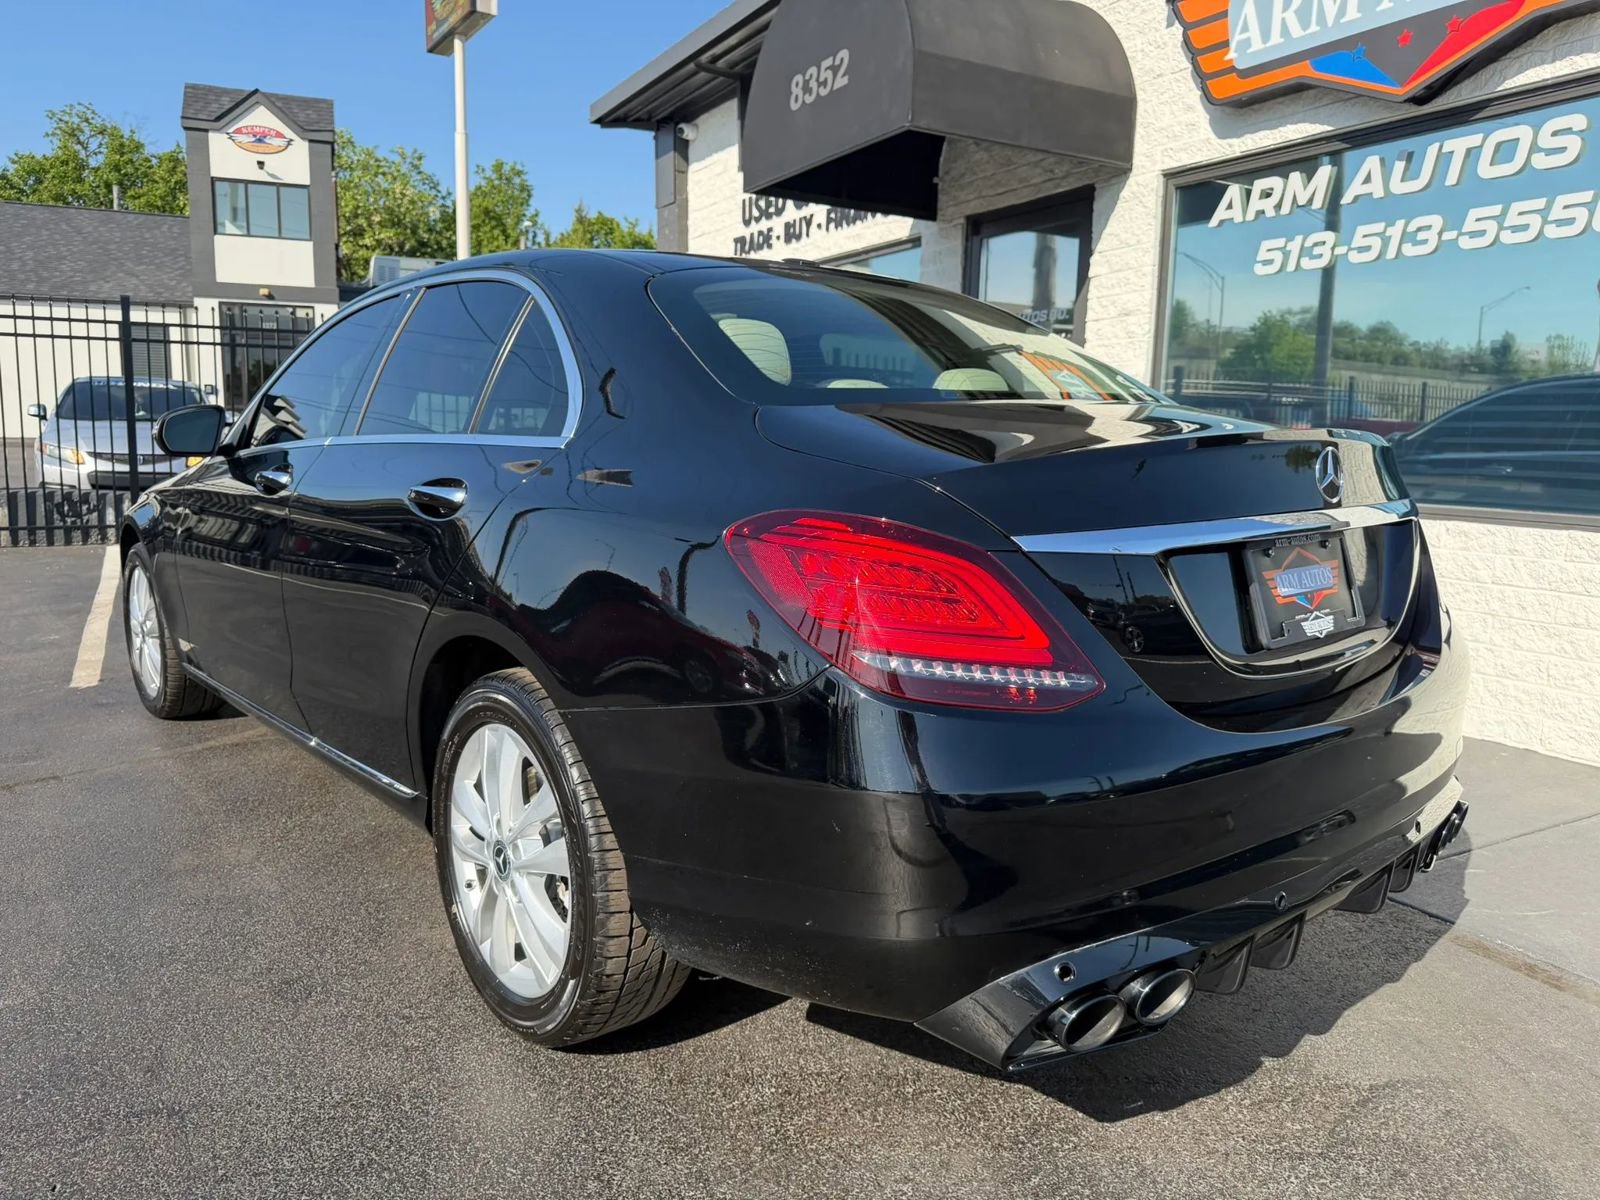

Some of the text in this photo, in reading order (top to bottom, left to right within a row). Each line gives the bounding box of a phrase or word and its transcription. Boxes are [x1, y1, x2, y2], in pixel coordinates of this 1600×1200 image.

[790, 49, 850, 111] 8352
[1208, 113, 1588, 228] ARM AUTOS
[733, 227, 773, 256] TRADE
[784, 213, 814, 245] BUY
[742, 196, 786, 228] USED
[1253, 190, 1600, 277] 513-513-555
[1276, 567, 1333, 592] ARM AUTOS
